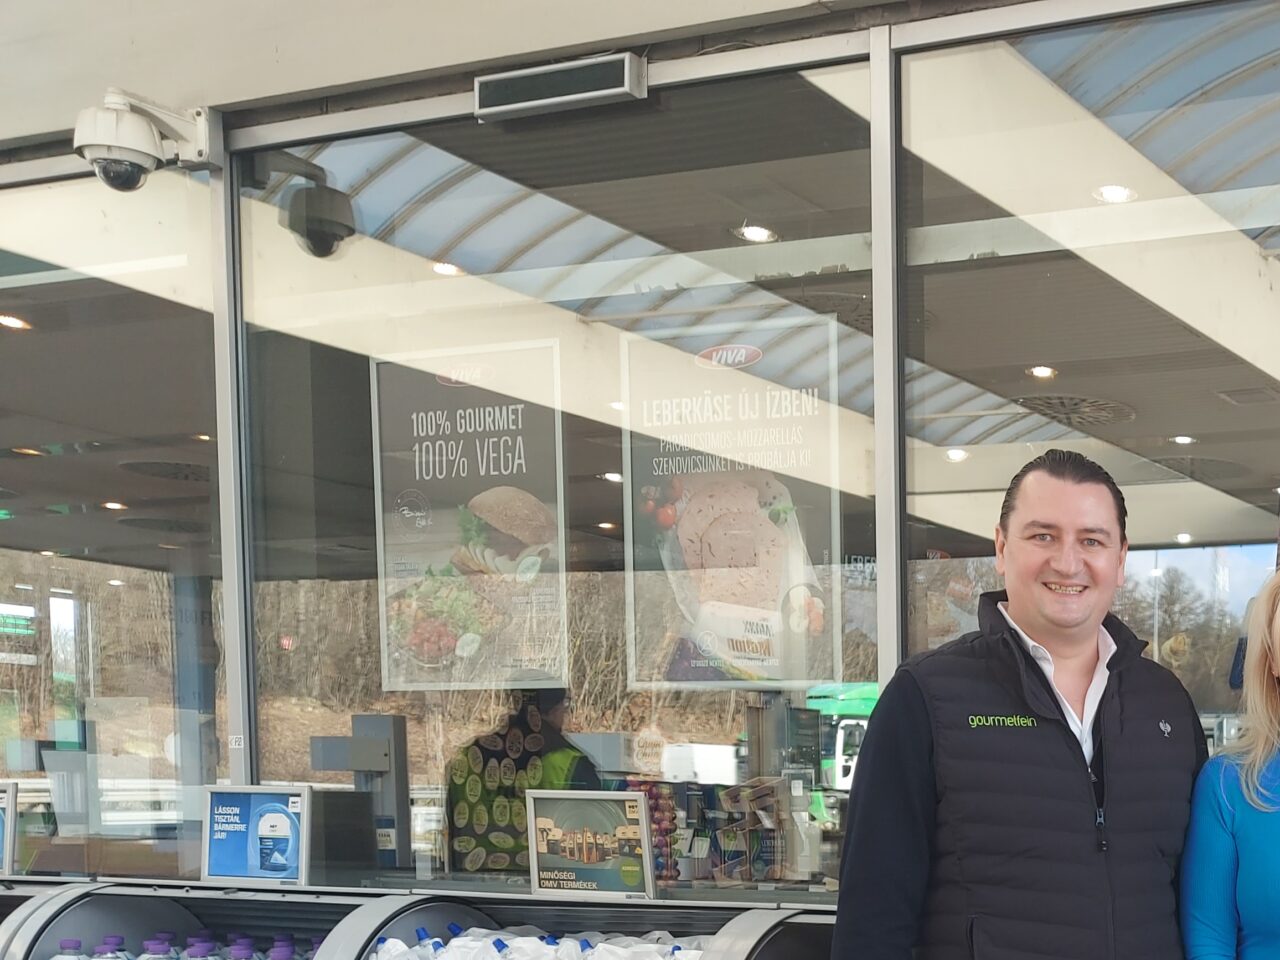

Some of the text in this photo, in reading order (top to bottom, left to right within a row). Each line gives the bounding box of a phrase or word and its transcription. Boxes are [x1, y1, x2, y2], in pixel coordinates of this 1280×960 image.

[711, 349, 747, 365] VIVA
[642, 386, 820, 428] LEBERKÄSE ÚJ ÍZBEN!
[411, 404, 525, 437] 100% GOURMET
[412, 435, 527, 480] 100% VEGA
[968, 714, 1037, 729] gourmetfein
[214, 805, 240, 815] LÁSSON
[540, 880, 598, 890] OMV TERMÉKEK
